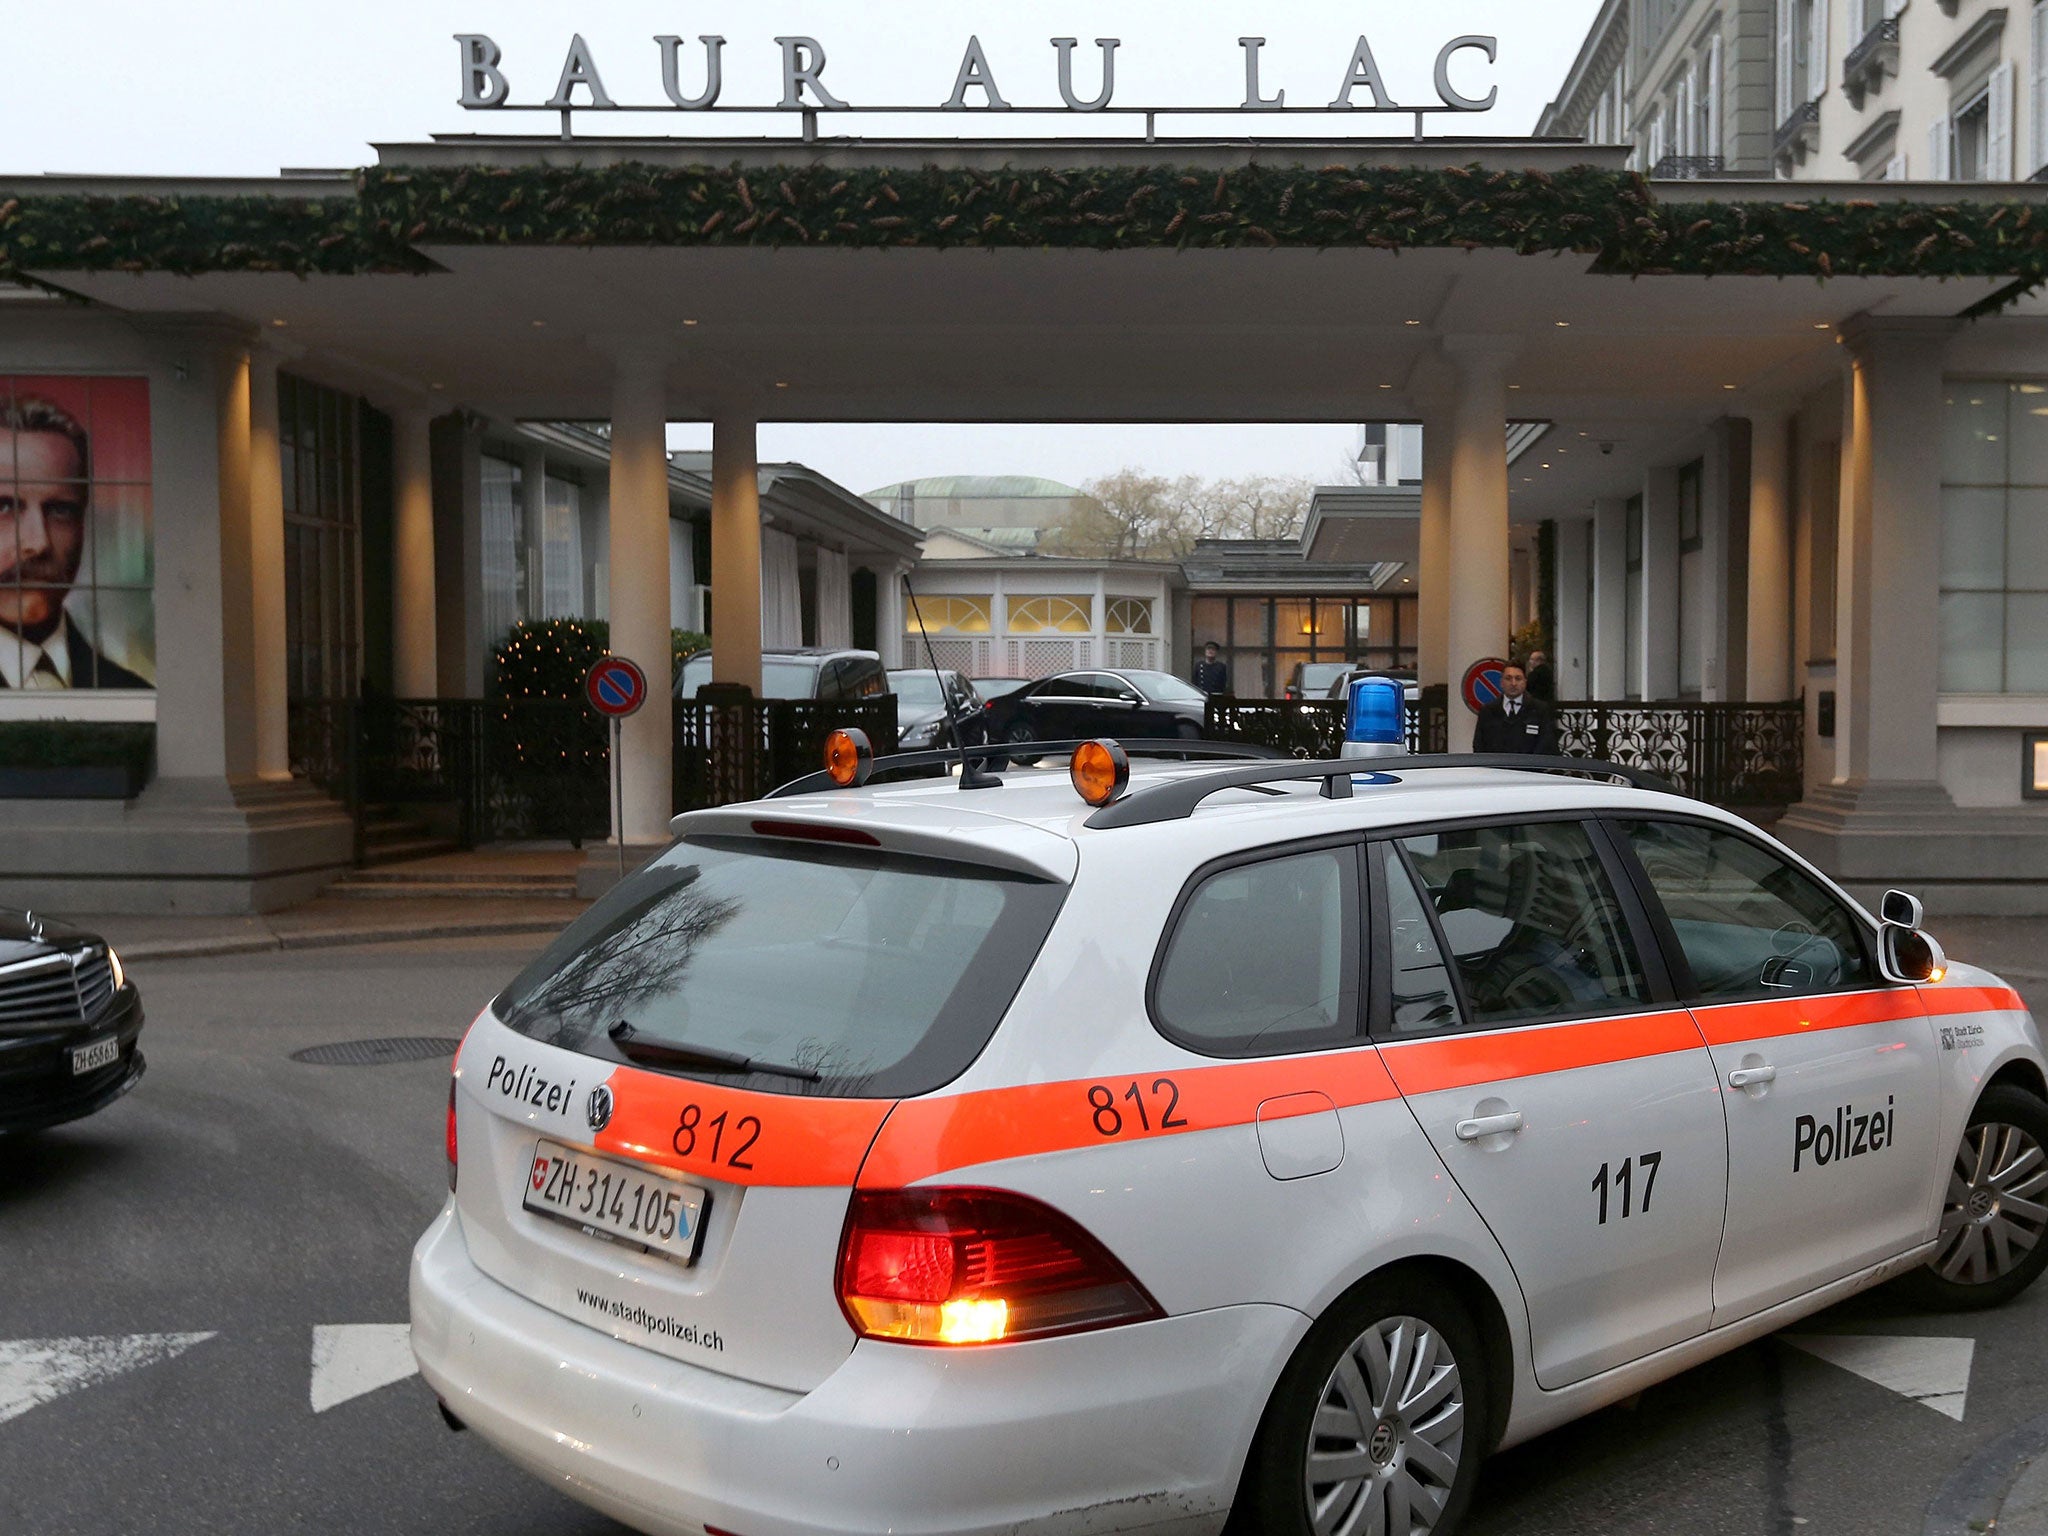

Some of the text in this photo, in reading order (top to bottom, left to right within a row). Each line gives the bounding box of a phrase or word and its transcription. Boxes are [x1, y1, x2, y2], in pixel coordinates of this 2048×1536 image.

[453, 33, 1498, 111] BAUR AU LAC
[487, 1055, 576, 1116] Polizei
[1087, 1078, 1188, 1136] 812
[672, 1103, 762, 1171] 812
[1793, 1095, 1895, 1173] Polizei
[1591, 1150, 1662, 1226] 117
[577, 1287, 724, 1352] www.stadtpolizei.ch
